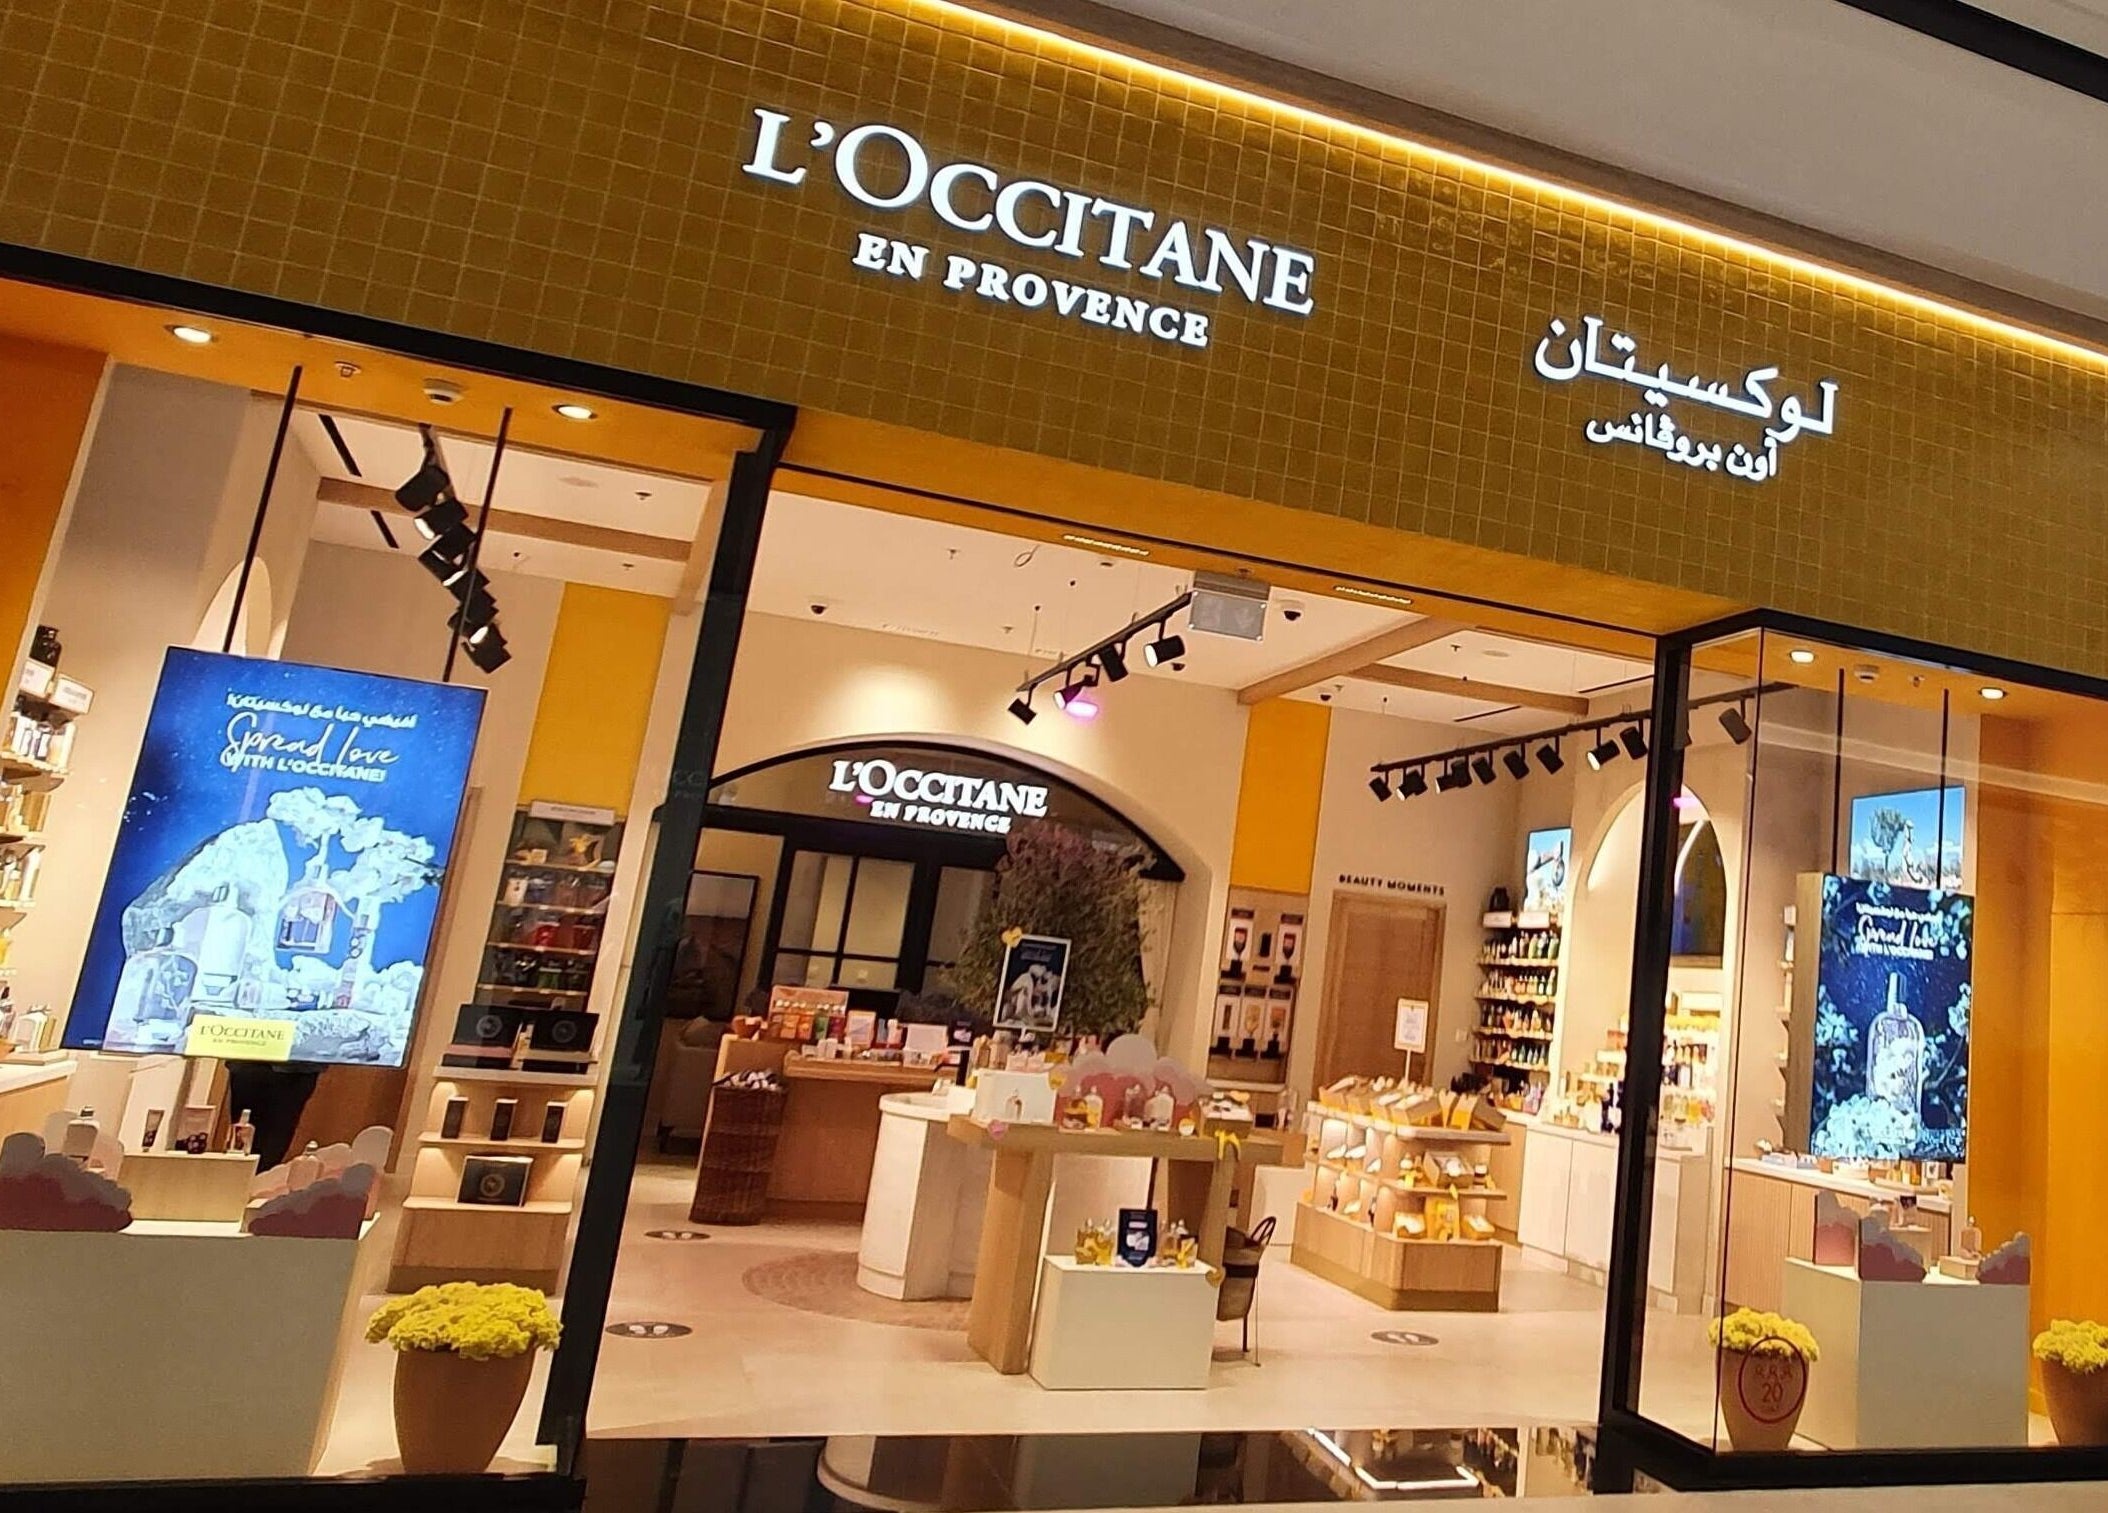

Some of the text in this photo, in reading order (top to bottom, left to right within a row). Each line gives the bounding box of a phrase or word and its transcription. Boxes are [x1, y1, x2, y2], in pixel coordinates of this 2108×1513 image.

[743, 109, 1313, 315] L'OCCITANE
[852, 233, 1209, 346] EN PROVENCE
[1536, 315, 1838, 442] لوكسيتان
[220, 711, 399, 771] Spread love
[829, 759, 1049, 818] L'OCCITANE
[869, 800, 1012, 834] EN PROVENCE
[1338, 874, 1445, 897] BEAUTY MOMENTS
[200, 1024, 285, 1041] L'OCCITANE
